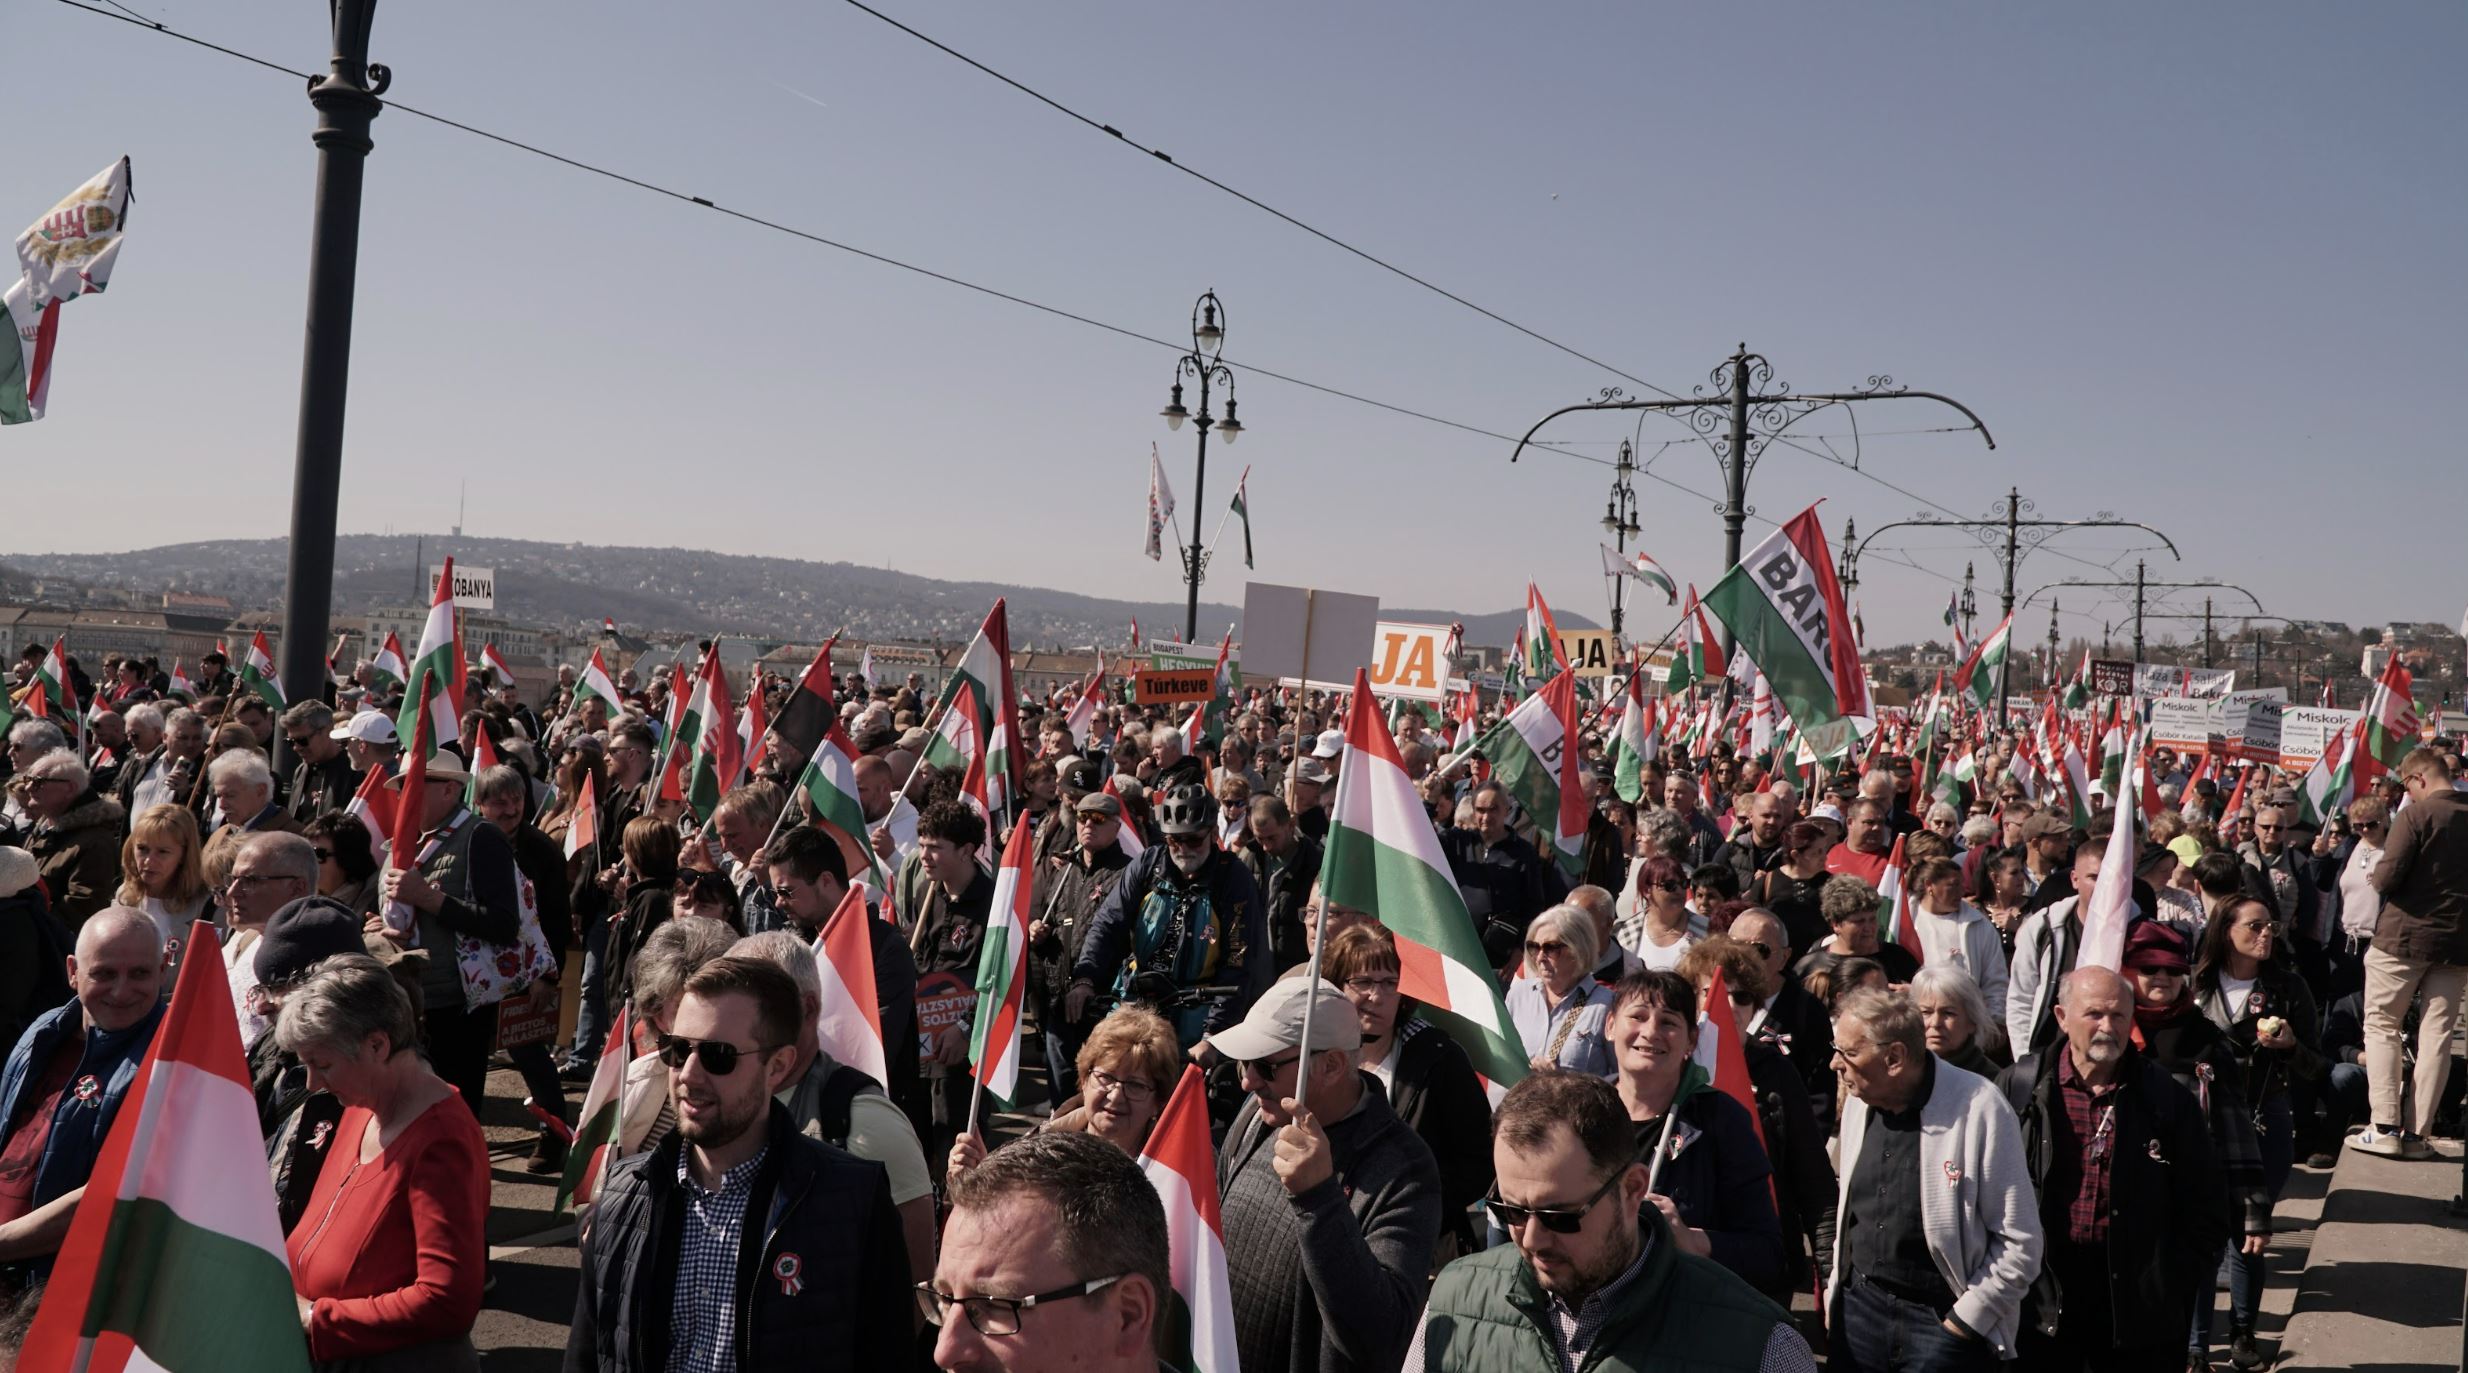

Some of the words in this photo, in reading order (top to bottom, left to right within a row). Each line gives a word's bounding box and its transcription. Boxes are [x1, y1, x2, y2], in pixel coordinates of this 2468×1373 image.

[454, 571, 492, 599] ŐBÁNYA
[1153, 643, 1184, 655] BUDAPEST
[2141, 668, 2168, 681] Haza
[1145, 677, 1208, 695] Túrkeve
[2096, 677, 2129, 694] KÖR
[2162, 702, 2198, 713] Miskolc
[2297, 712, 2351, 725] Miskolc
